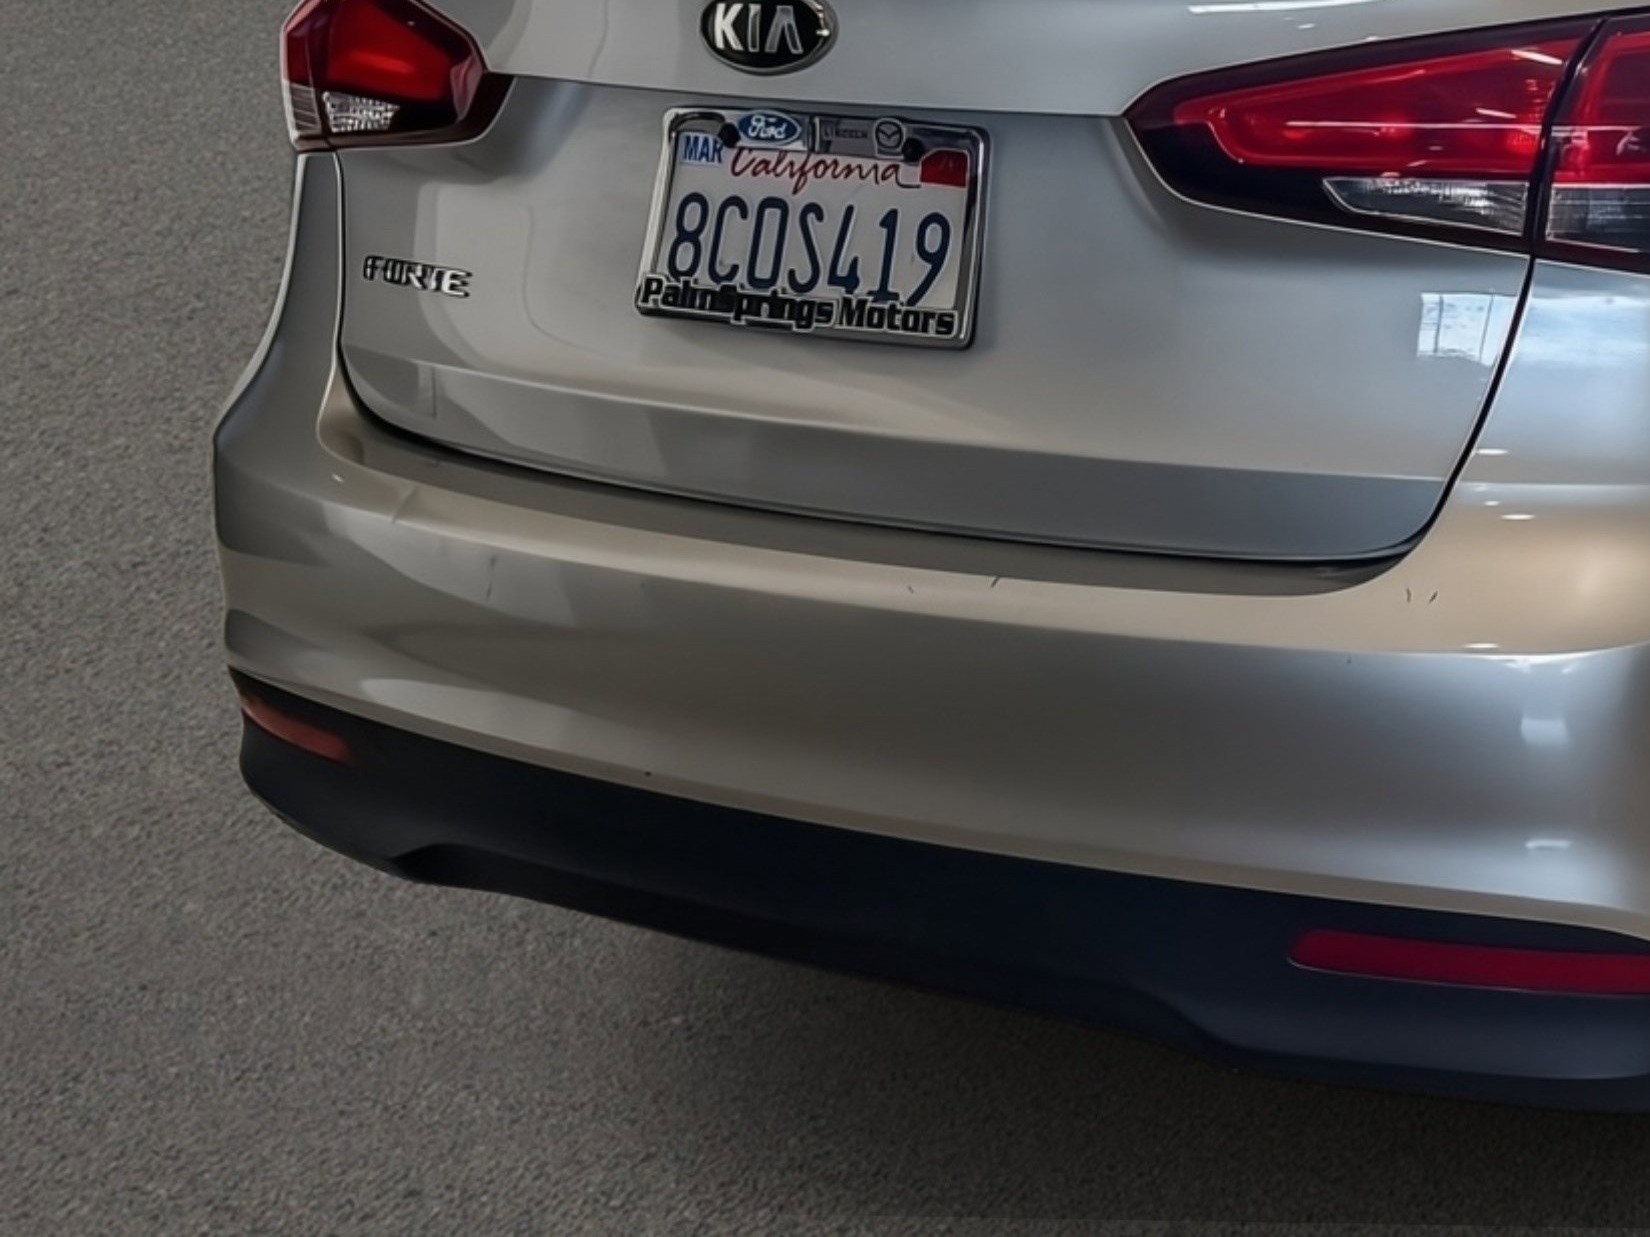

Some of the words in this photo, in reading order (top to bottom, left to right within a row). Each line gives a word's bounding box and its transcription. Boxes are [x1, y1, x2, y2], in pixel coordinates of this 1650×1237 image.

[714, 3, 804, 54] KIA
[748, 115, 788, 140] Ford
[683, 136, 723, 164] MAR
[730, 147, 922, 195] California
[667, 191, 951, 306] 8COS419
[363, 255, 473, 298] FORTE
[838, 297, 956, 337] Motors
